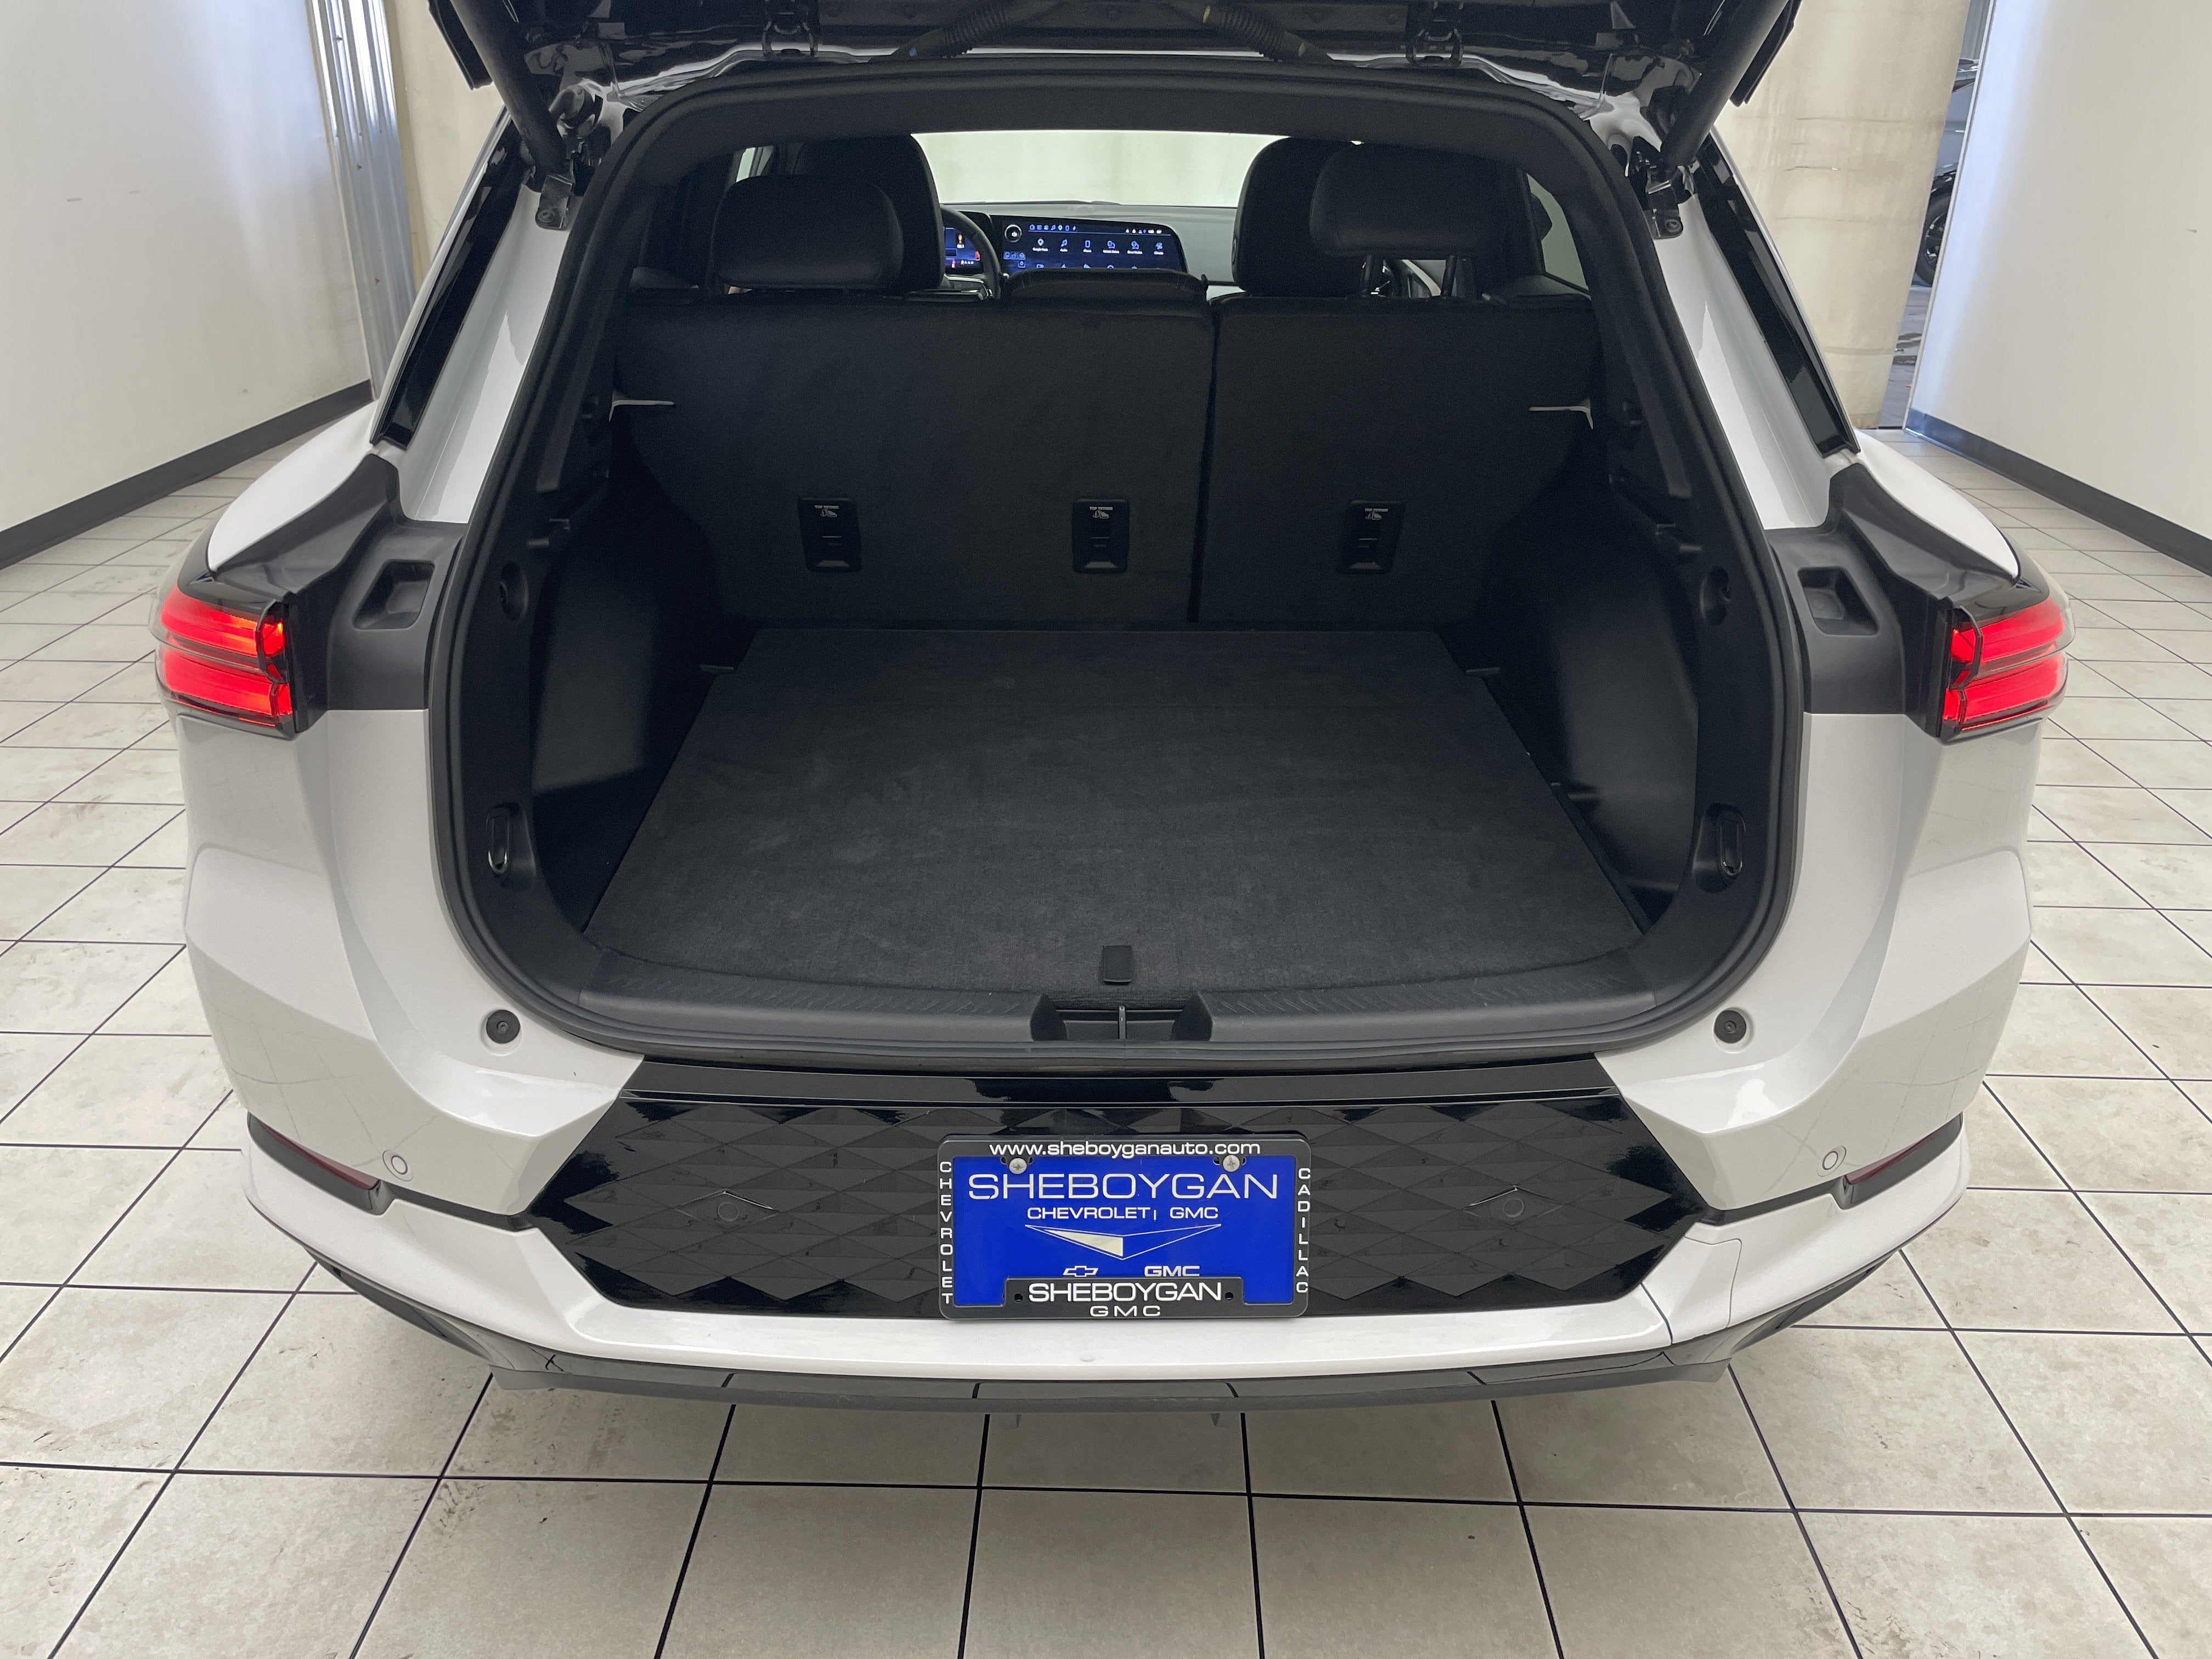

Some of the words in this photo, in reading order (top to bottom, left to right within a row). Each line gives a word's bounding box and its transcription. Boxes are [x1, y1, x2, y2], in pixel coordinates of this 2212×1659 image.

[990, 1141, 1260, 1158] www.sheboyganauto.com
[968, 1173, 1277, 1200] SHEBOYGAN
[1027, 1207, 1151, 1220] CHEVROLET
[1170, 1207, 1218, 1219] GMC
[939, 1161, 953, 1304] CHEVROLET
[1296, 1168, 1311, 1293] CADILLAC
[1144, 1266, 1200, 1277] GMC
[1028, 1282, 1222, 1302] SHEBOYGAN
[1090, 1305, 1161, 1317] GMC
